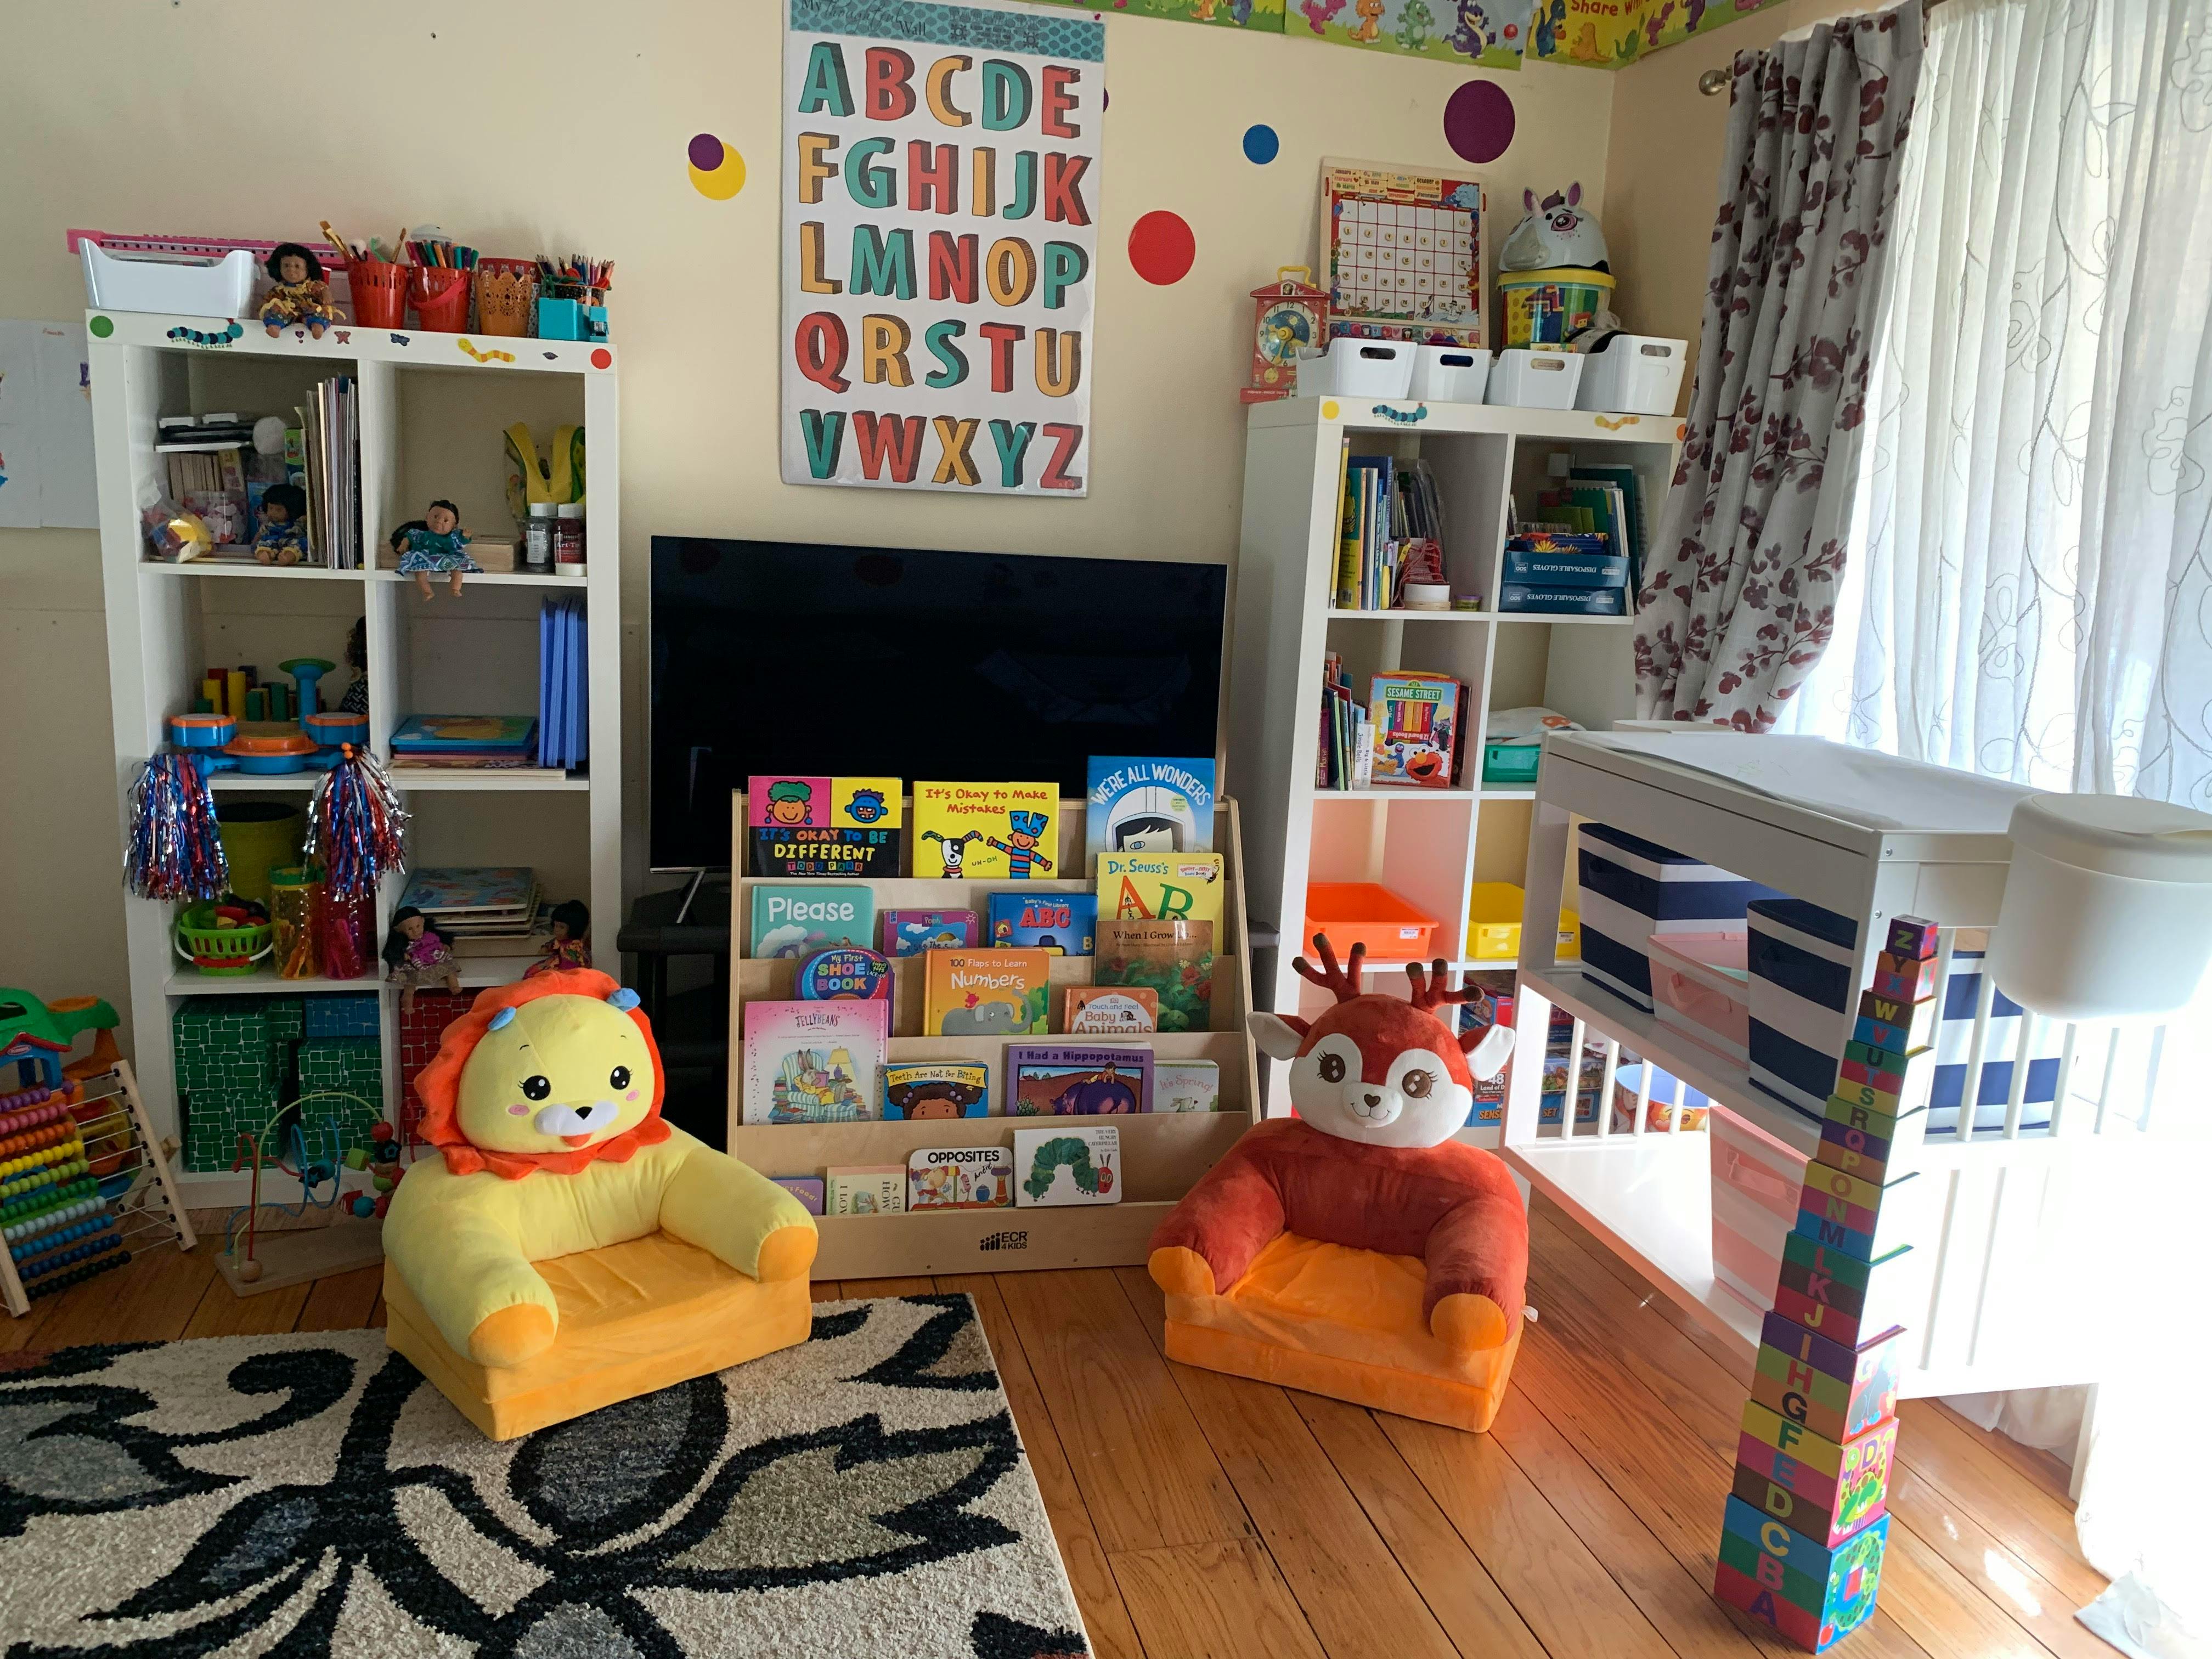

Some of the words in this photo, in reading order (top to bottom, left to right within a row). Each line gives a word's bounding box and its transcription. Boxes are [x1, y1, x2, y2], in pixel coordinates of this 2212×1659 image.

[1571, 0, 1618, 16] Share
[900, 21, 926, 36] Wall
[1387, 687, 1414, 698] SESAME
[1415, 689, 1441, 700] STREET
[1091, 770, 1128, 805] WE'RE
[1127, 764, 1150, 785] ALL
[1152, 763, 1211, 806] WONDERS
[926, 789, 951, 800] It's
[956, 789, 989, 802] Okay
[994, 789, 1008, 799] to
[1012, 790, 1048, 800] Make
[946, 803, 1006, 814] Mistakes
[759, 828, 791, 841] IT'S
[796, 829, 839, 842] OKAY
[843, 830, 862, 841] TO
[868, 831, 888, 844] BE
[774, 843, 876, 862] DIFFERENT
[787, 861, 823, 871] TODD
[828, 861, 863, 872] PARR
[1108, 861, 1126, 874] Dr.
[1129, 859, 1169, 874] Seuss's
[768, 897, 854, 922] Please
[1019, 907, 1071, 928] ABC
[1082, 936, 1093, 951] B
[1113, 931, 1141, 939] When
[1150, 931, 1174, 939] Grow
[1894, 930, 1914, 950] Z
[831, 955, 841, 963] My
[968, 959, 990, 968] Flaps
[1005, 959, 1027, 967] Learn
[1892, 956, 1908, 973] Y
[817, 963, 865, 976] SHOE
[817, 978, 867, 991] BOOK
[951, 970, 1025, 990] Numbers
[1887, 974, 1905, 995] X
[1085, 1011, 1115, 1023] Baby
[1875, 1000, 1898, 1021] W
[795, 1013, 840, 1028] JELLYBEANS
[1075, 1022, 1152, 1033] Animals
[1873, 1025, 1891, 1043] V
[1019, 1051, 1023, 1059] I
[1027, 1051, 1048, 1060] Had
[1063, 1051, 1144, 1063] Hippopotamus
[1866, 1047, 1884, 1066] U
[890, 1073, 912, 1082] Teeth
[930, 1070, 943, 1078] Not
[957, 1070, 981, 1084] Biting
[1159, 1077, 1174, 1090] It's
[1175, 1074, 1214, 1093] Spring!
[1865, 1066, 1880, 1086] T
[1859, 1087, 1875, 1106] S
[1542, 1108, 1559, 1118] SET
[1850, 1107, 1869, 1130] R
[1845, 1130, 1865, 1152] Q
[928, 1150, 1000, 1164] OPPOSITES
[1841, 1150, 1860, 1170] P
[1831, 1174, 1852, 1197] O
[1826, 1197, 1847, 1223] N
[1001, 1231, 1028, 1243] ECR
[1818, 1220, 1846, 1248] M
[1814, 1246, 1832, 1275] L
[1807, 1273, 1832, 1304] K
[1804, 1304, 1824, 1328] J
[1800, 1334, 1812, 1361] I
[1787, 1359, 1813, 1393] H
[1782, 1391, 1808, 1424] G
[1778, 1421, 1803, 1449] F
[1862, 1440, 1878, 1470] D
[1771, 1453, 1797, 1488] E
[1765, 1482, 1793, 1516] D
[1760, 1522, 1791, 1556] C
[1757, 1551, 1783, 1590] B
[1750, 1592, 1776, 1627] A
